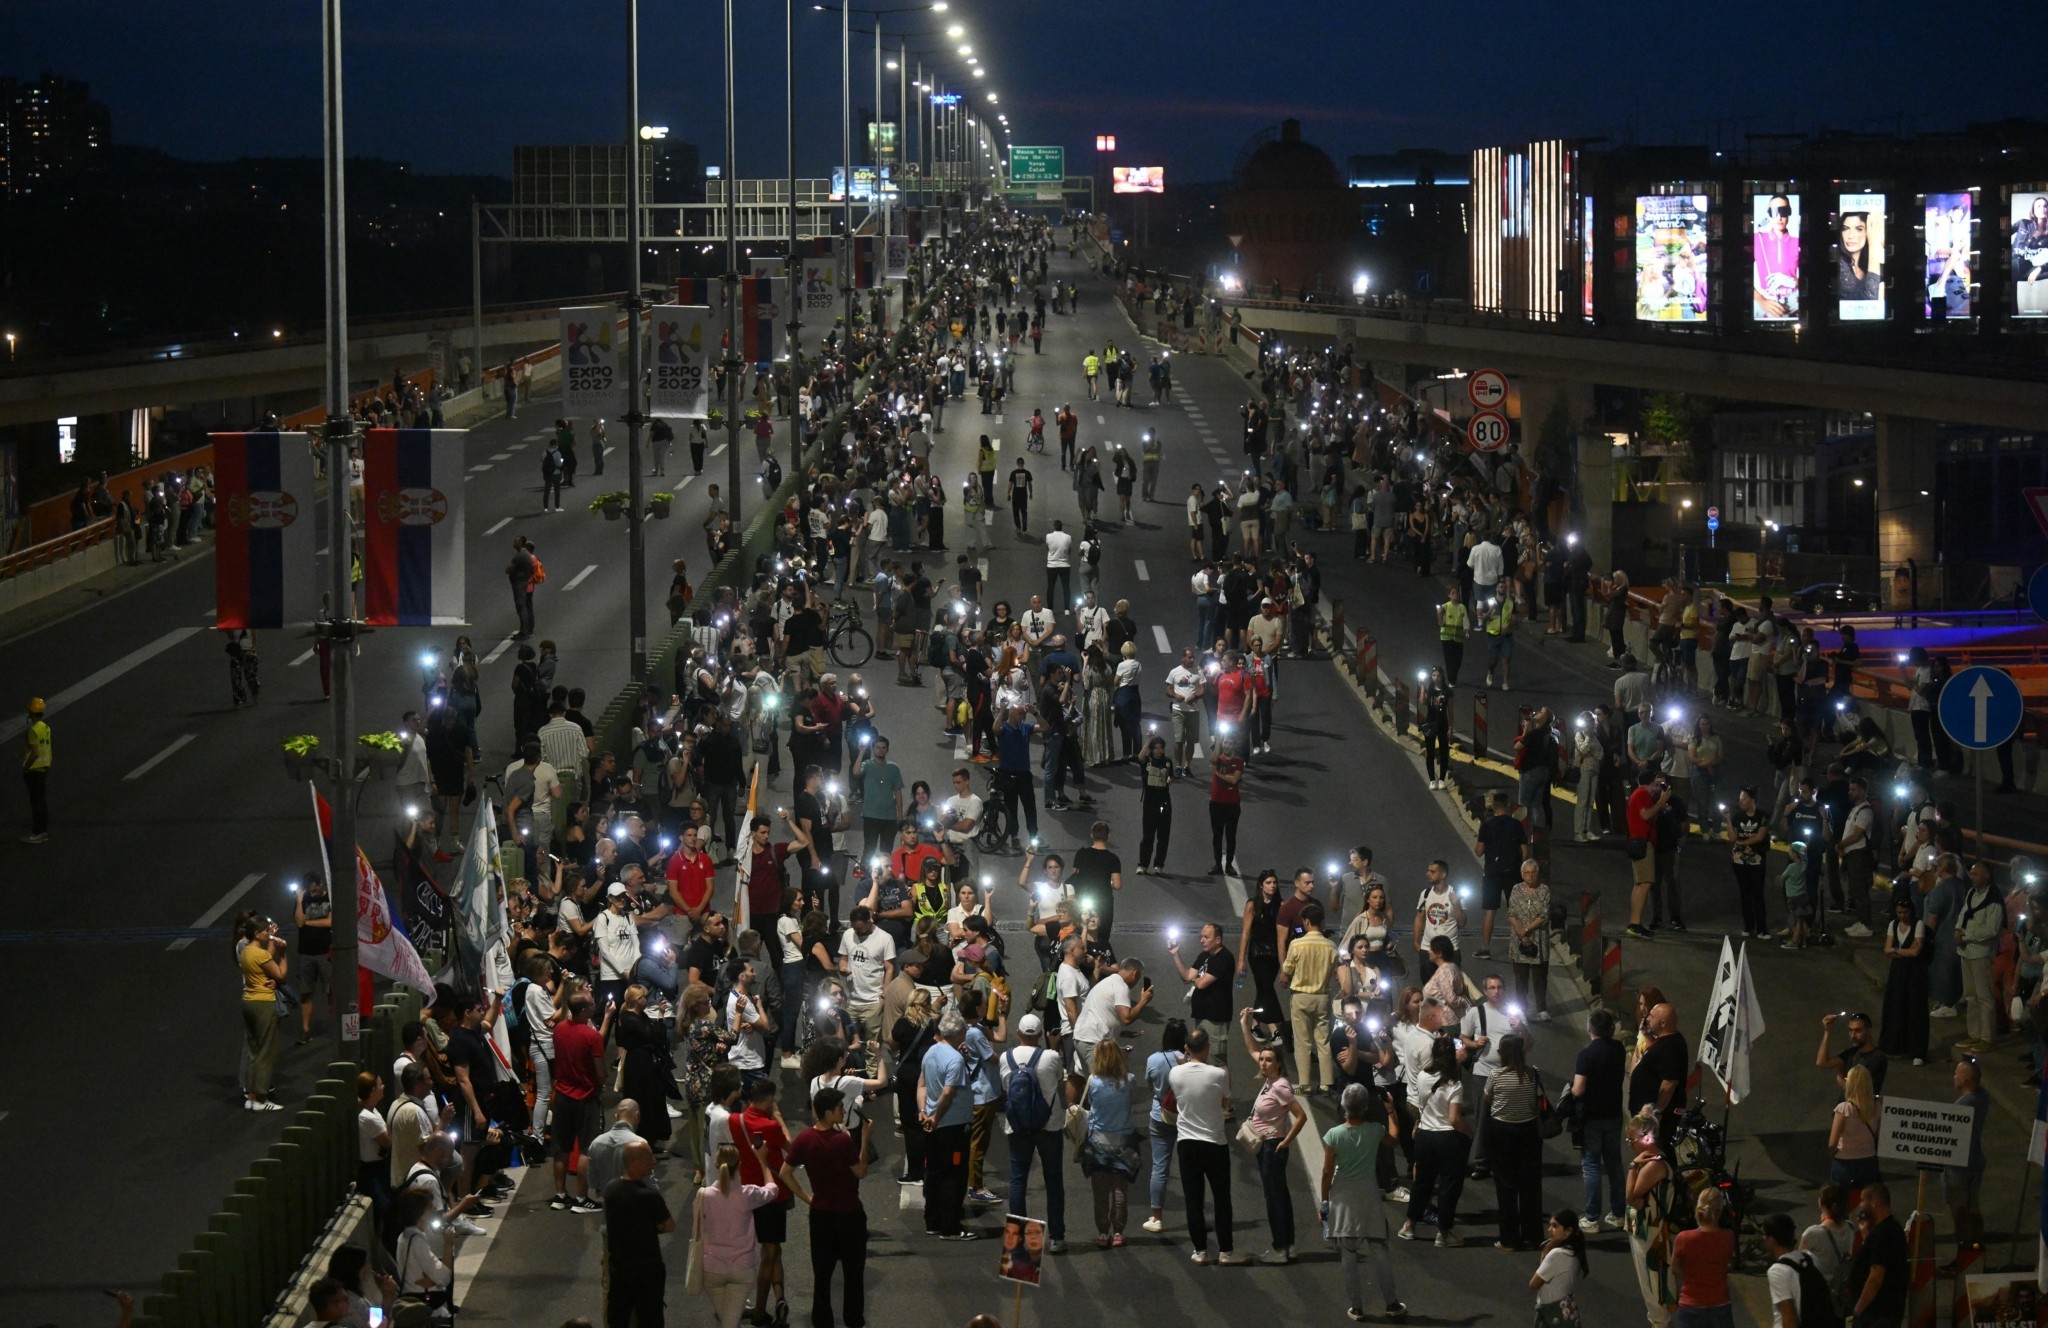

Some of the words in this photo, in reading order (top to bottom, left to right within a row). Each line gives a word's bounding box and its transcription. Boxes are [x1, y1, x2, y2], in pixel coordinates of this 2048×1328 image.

[570, 366, 613, 378] EXPO
[658, 366, 702, 378] EXPO
[570, 378, 613, 391] 2027
[658, 378, 702, 390] 2027
[1476, 421, 1501, 441] 80
[1884, 1106, 1937, 1120] ГОВОРИМ
[1941, 1113, 1971, 1123] ТИХО
[1900, 1120, 1908, 1128] И
[1911, 1121, 1952, 1133] ВОДИМ
[1892, 1131, 1958, 1146] КОМШИЛУК
[1896, 1144, 1910, 1153] СА
[1913, 1146, 1952, 1158] СОБОМ
